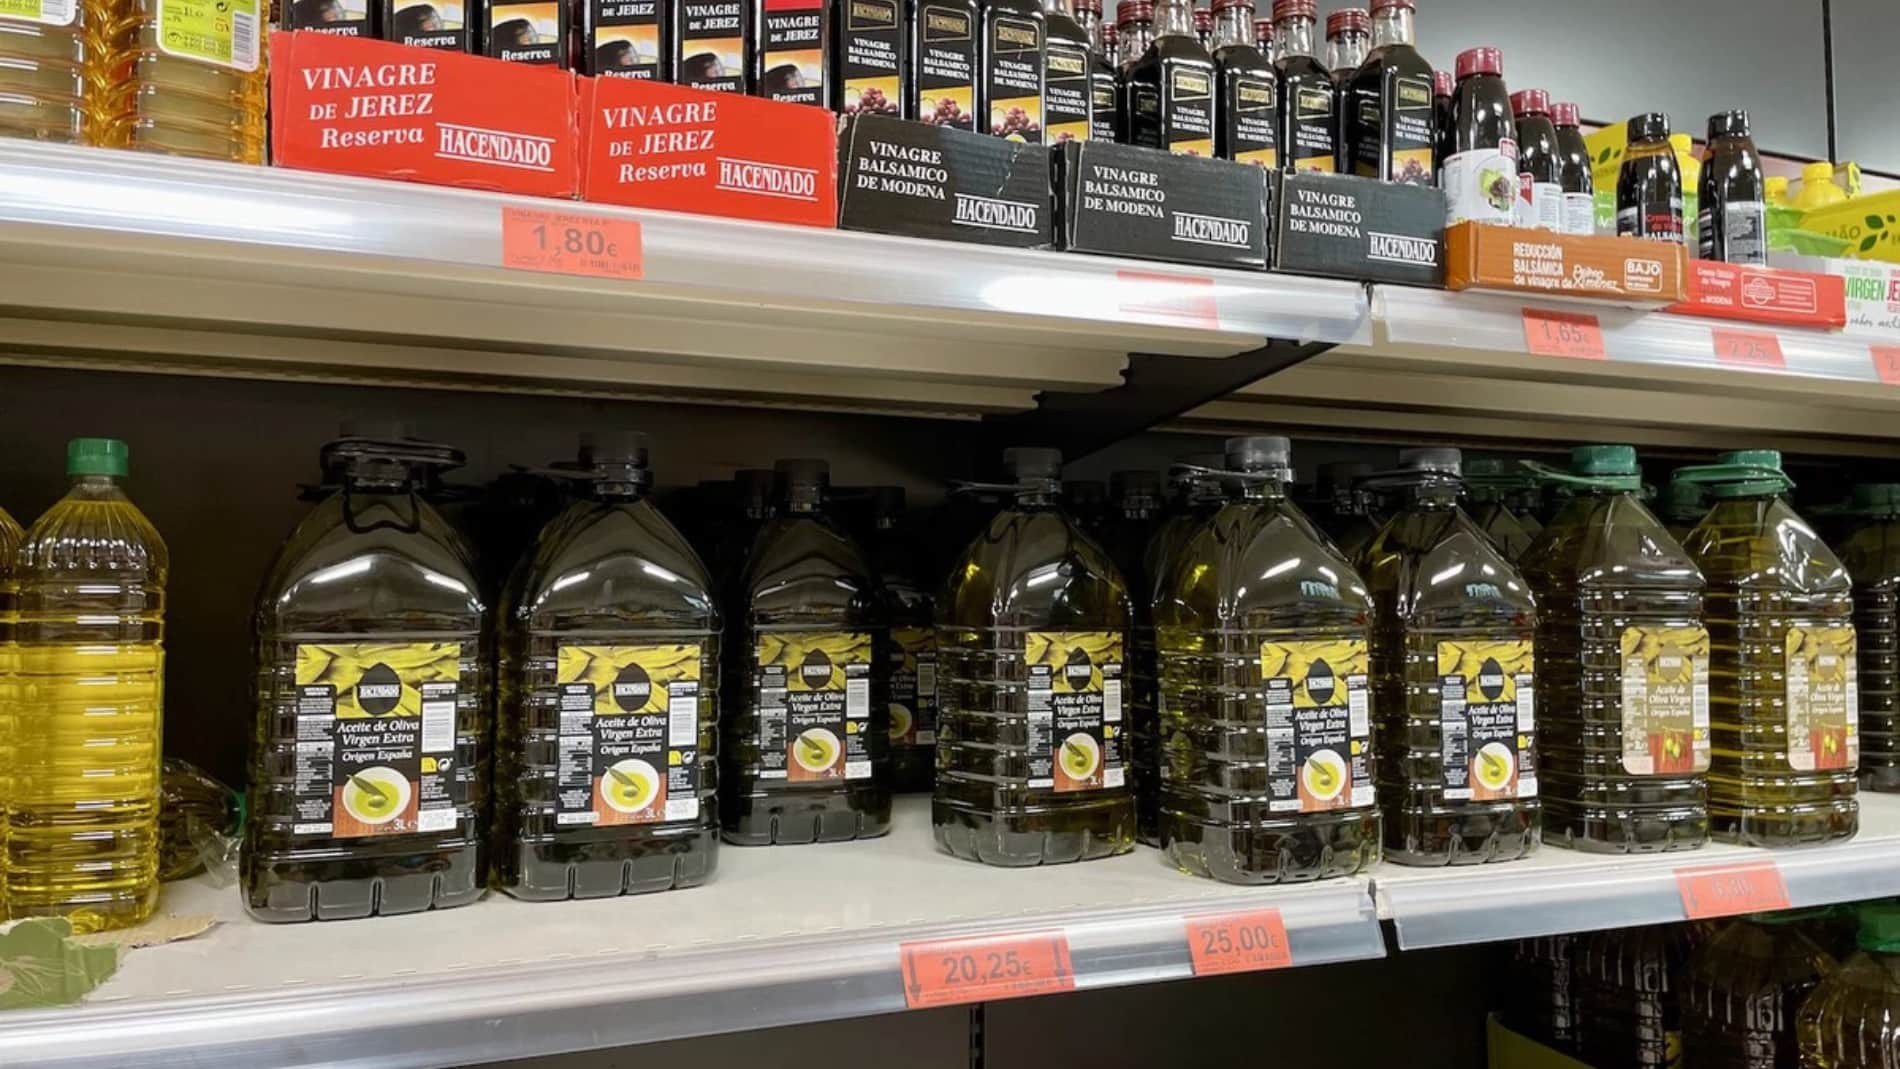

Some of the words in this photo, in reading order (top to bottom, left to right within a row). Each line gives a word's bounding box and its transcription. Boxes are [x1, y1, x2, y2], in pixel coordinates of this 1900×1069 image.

[602, 8, 615, 17] DE
[616, 3, 654, 16] JEREZ
[686, 4, 739, 16] VINAGRE
[689, 21, 701, 29] DE
[703, 17, 739, 29] JEREZ
[768, 16, 819, 29] VINAGRE
[404, 35, 456, 47] Reserva
[770, 33, 782, 42] DE
[783, 29, 818, 41] JEREZ
[501, 49, 551, 62] Reserva
[302, 63, 436, 90] VINAGRE
[309, 103, 336, 120] DE
[345, 93, 433, 118] JEREZ
[602, 102, 717, 128] VINAGRE
[321, 128, 424, 148] Reserva
[440, 128, 551, 166] HACENDADO
[609, 142, 632, 157] DE
[639, 130, 714, 154] JEREZ
[869, 141, 942, 165] VINAGRE
[619, 161, 706, 183] Reserva
[720, 162, 815, 196] HACENDADO
[859, 157, 948, 183] BALSAMICO
[1094, 166, 1158, 186] VINAGRE
[857, 174, 878, 190] DE
[881, 177, 945, 200] MODENA
[1085, 181, 1165, 202] BALSAMICO
[1084, 197, 1102, 212] DE
[1106, 200, 1164, 218] MODENA
[1298, 190, 1356, 208] VINAGRE
[956, 198, 1036, 228] HACENDADO
[1290, 203, 1361, 224] BALSAMICO
[1175, 216, 1248, 245] HACENDADO
[1290, 219, 1307, 232] DE
[1309, 222, 1361, 238] MODENA
[532, 224, 618, 257] 1,80€
[1370, 236, 1436, 262] HACENDADO
[1513, 242, 1562, 260] REDUCCIÓN
[1513, 258, 1563, 276] BALSÁMICA
[1627, 262, 1661, 276] BAJO
[1845, 277, 1886, 301] VIRGEN
[337, 720, 371, 733] Aceite
[374, 720, 387, 731] de
[389, 720, 419, 731] Oliva
[596, 717, 625, 729] Aceite
[627, 717, 639, 727] de
[641, 716, 667, 727] Oliva
[343, 733, 380, 746] Virgen
[382, 733, 414, 744] Extra
[601, 728, 633, 741] Virgen
[636, 728, 663, 738] Extra
[342, 750, 375, 763] Origen
[377, 750, 412, 761] España
[601, 745, 629, 756] Origen
[631, 744, 661, 755] España
[1201, 925, 1281, 957] 25,00€
[942, 950, 1032, 985] 20,25€
